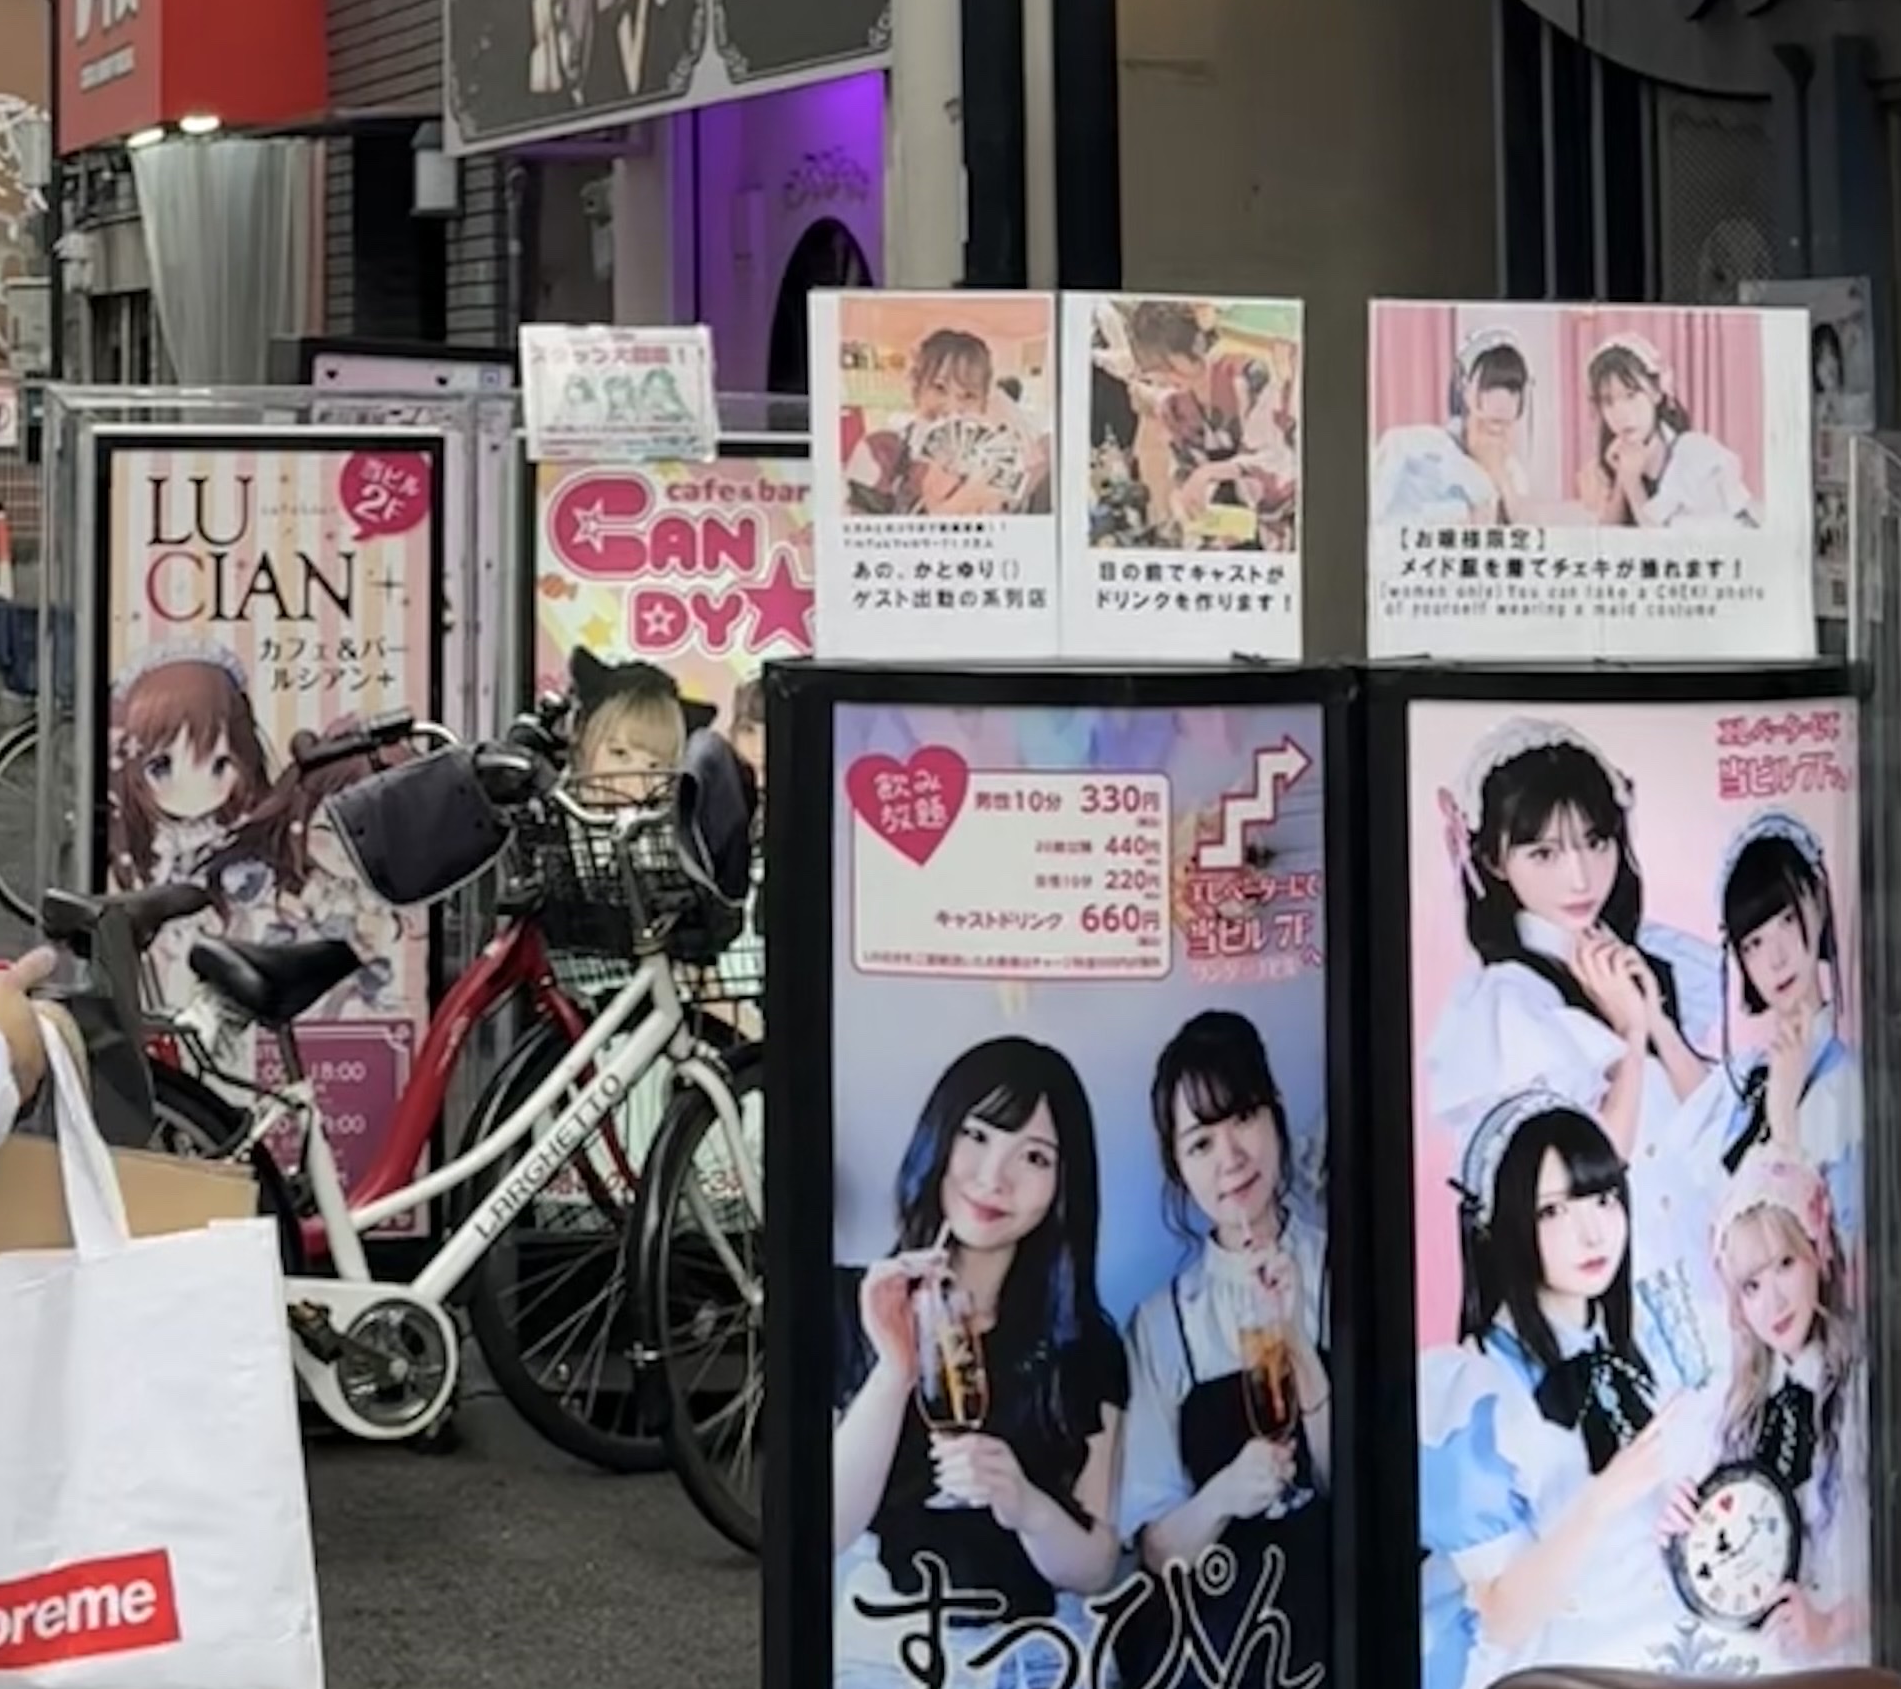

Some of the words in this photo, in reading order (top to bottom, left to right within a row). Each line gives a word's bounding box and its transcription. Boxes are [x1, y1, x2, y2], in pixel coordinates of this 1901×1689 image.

[146, 475, 254, 546] LU
[145, 550, 356, 622] CIAN
[1080, 784, 1161, 813] 330円
[1080, 902, 1161, 934] 660円
[473, 1071, 625, 1243] LARGHETTO
